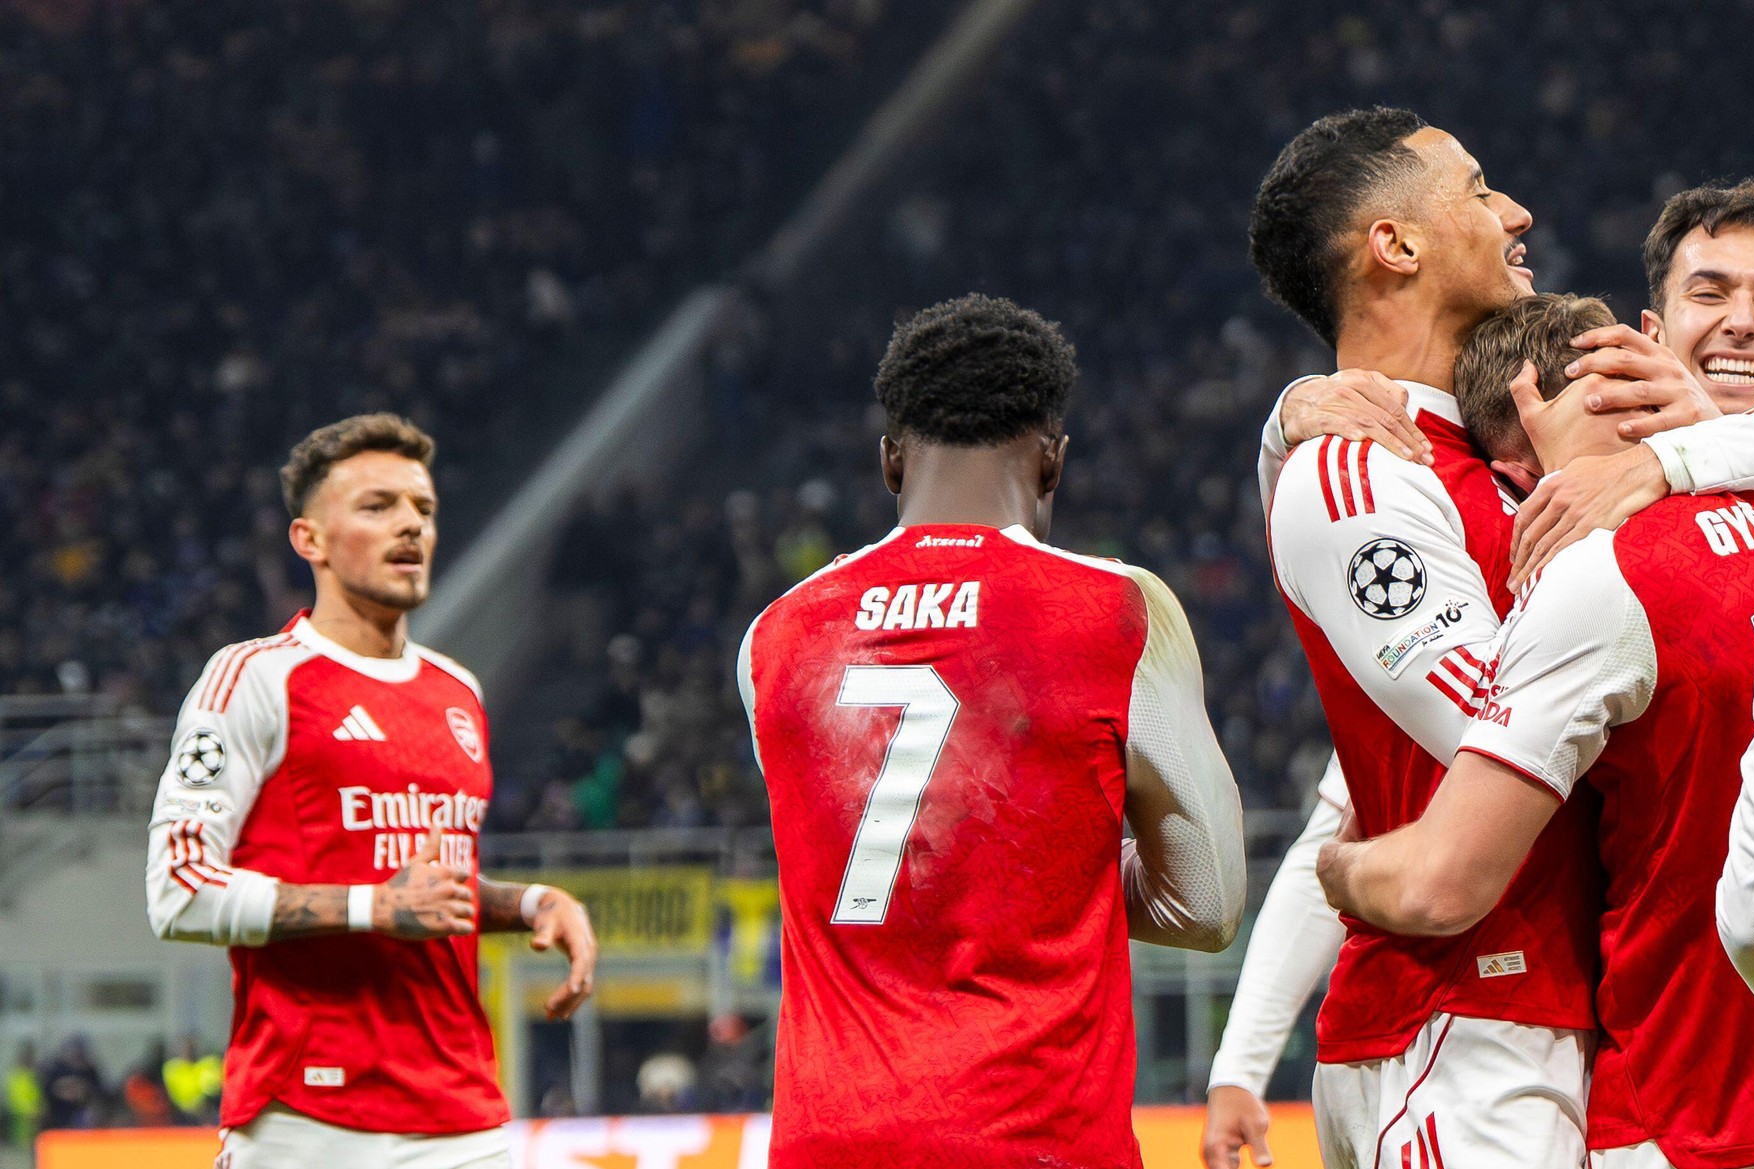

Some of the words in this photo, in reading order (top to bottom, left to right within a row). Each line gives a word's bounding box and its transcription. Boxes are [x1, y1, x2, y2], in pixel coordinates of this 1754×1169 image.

[915, 534, 985, 548] Arsenal
[855, 581, 981, 631] SAKA
[1382, 622, 1439, 669] FOUNDATION
[338, 782, 489, 833] Emirates
[830, 664, 961, 926] 7
